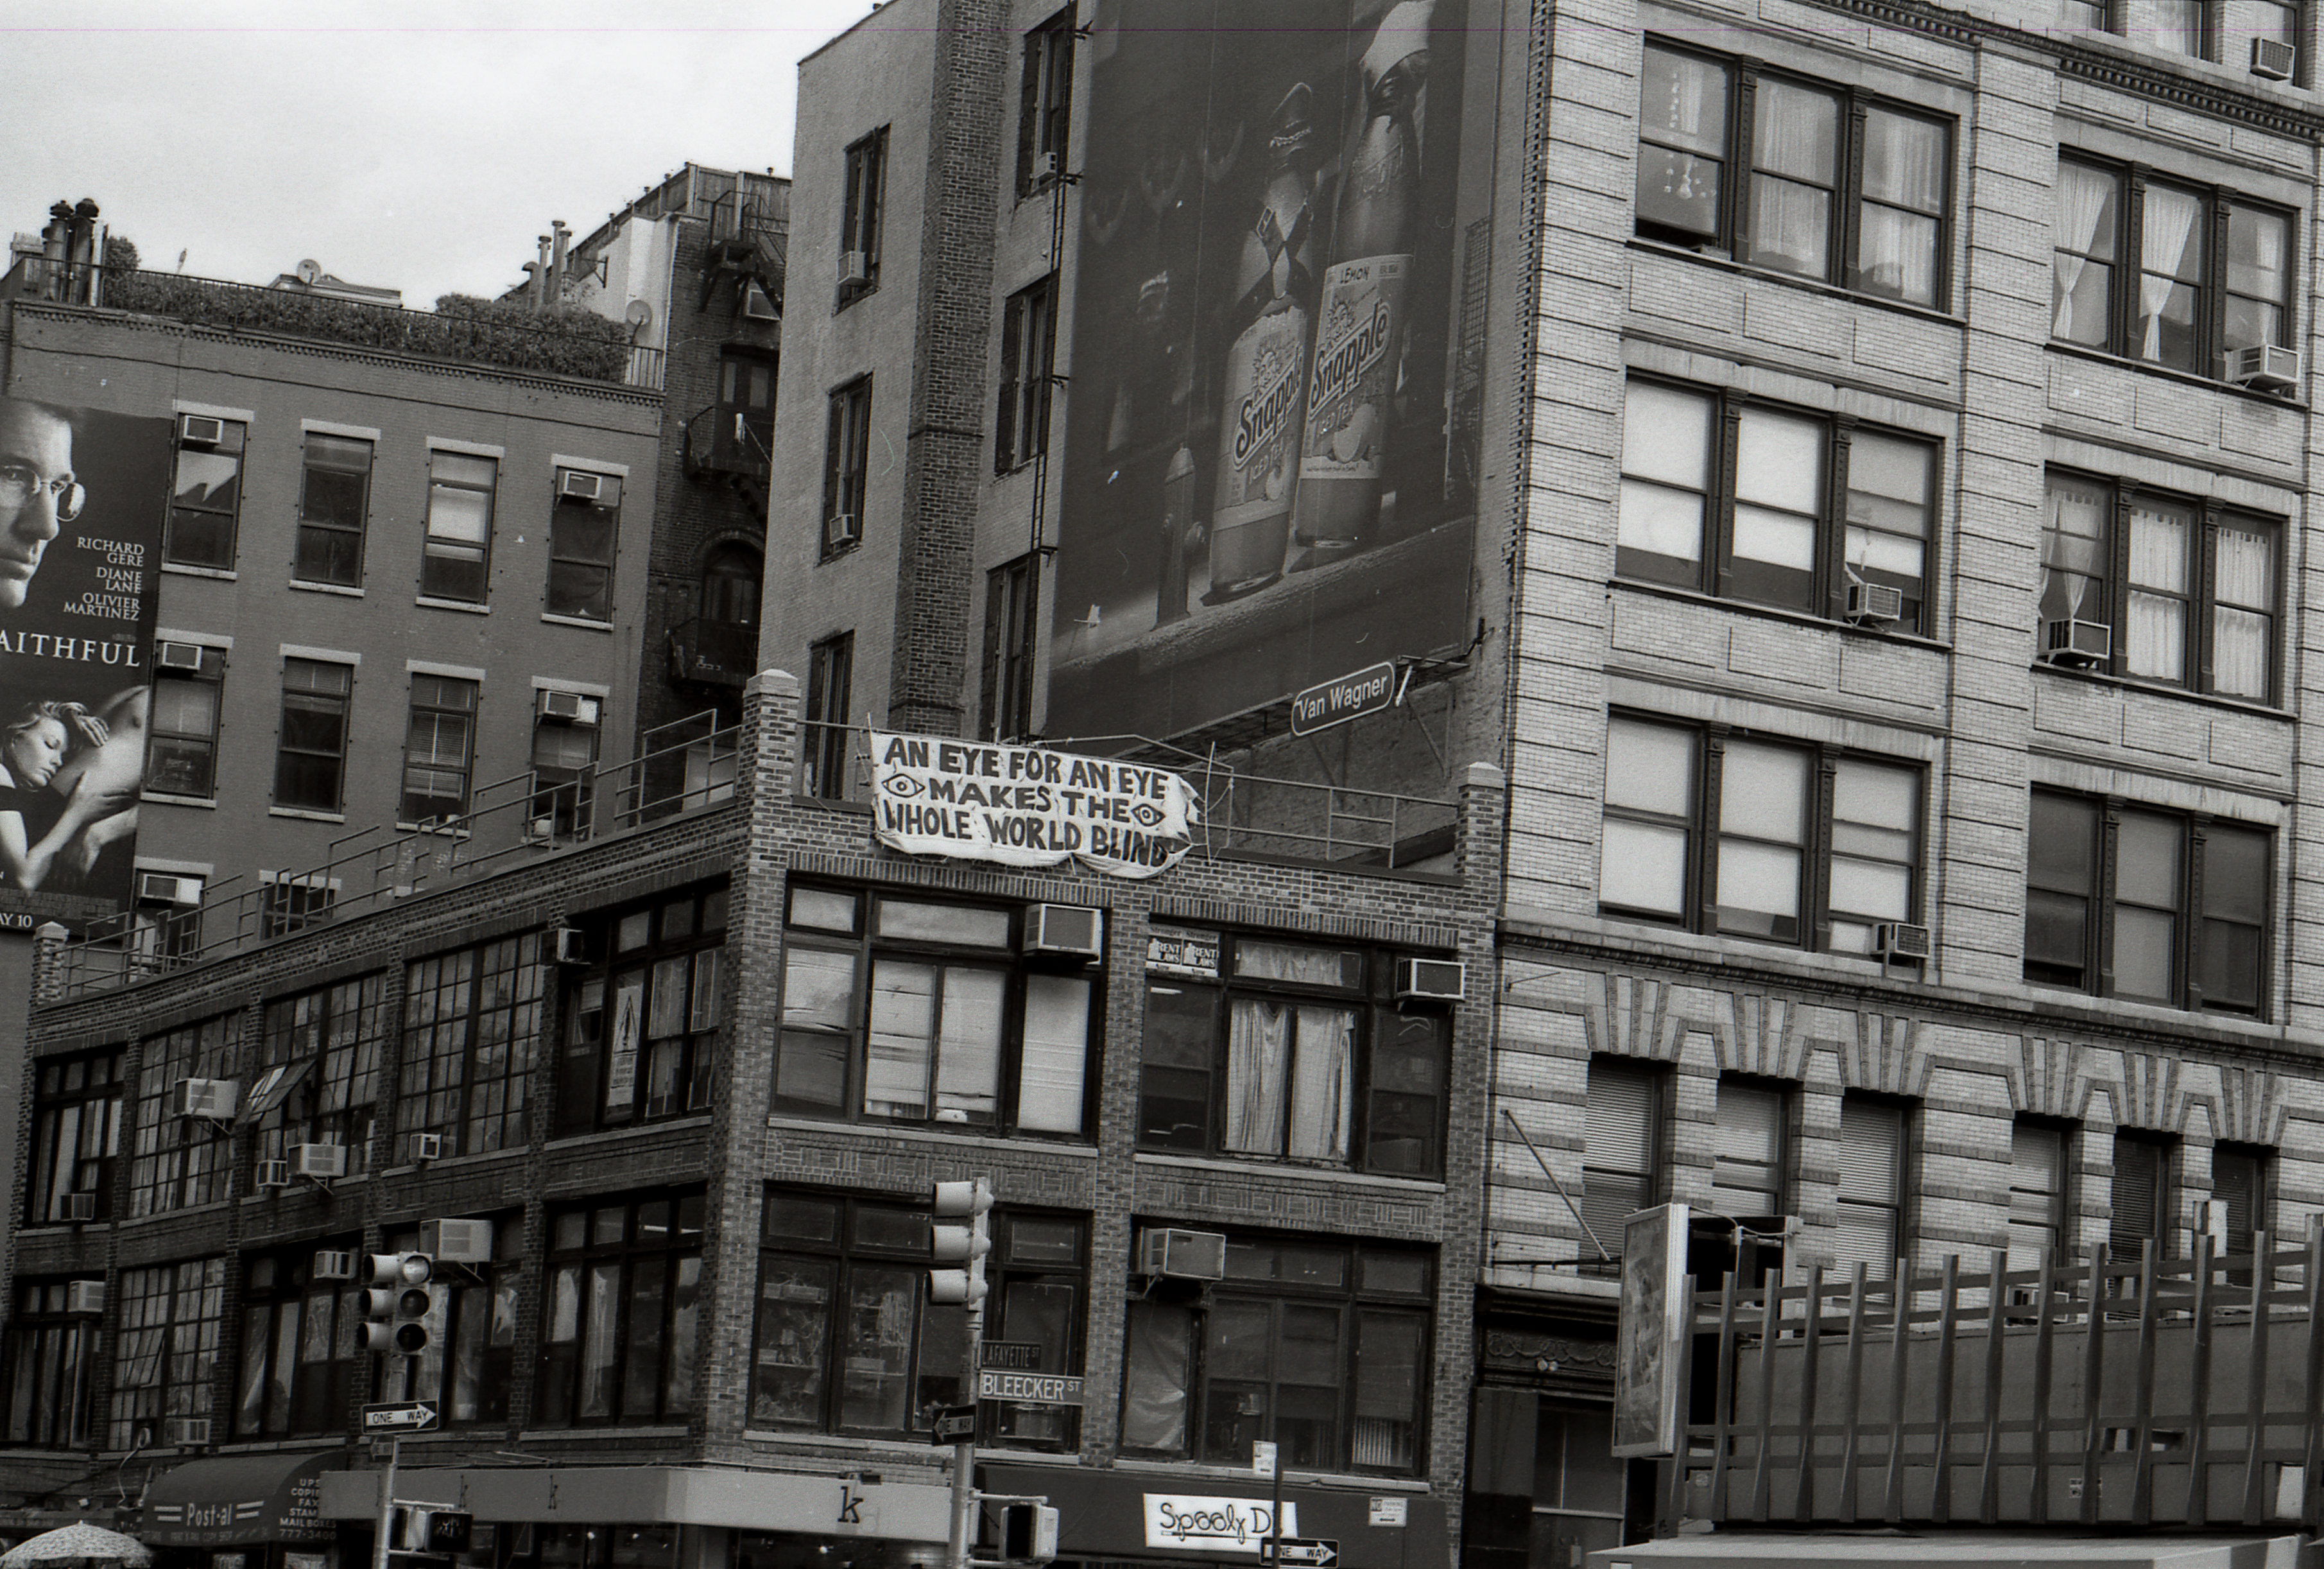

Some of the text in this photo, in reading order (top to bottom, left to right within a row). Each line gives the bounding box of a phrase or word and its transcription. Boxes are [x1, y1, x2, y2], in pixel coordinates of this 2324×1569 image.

[1339, 266, 1370, 284] LEMON
[1310, 299, 1388, 409] Snapple
[77, 537, 145, 556] RICHARD
[107, 553, 144, 567] GERE
[96, 567, 142, 583] DIANE
[105, 579, 141, 594] LANE
[82, 593, 141, 610] OLIVIER
[64, 602, 139, 621] MARTINEZ
[1295, 675, 1388, 722] Van Wagner
[884, 738, 1169, 800] AN EYE FOR AN EYE
[929, 777, 1132, 824] MAKES THE
[883, 799, 1169, 867] WHOLE WORLD BLIND
[17, 914, 33, 928] 10
[1158, 942, 1181, 954] RENT
[1194, 947, 1218, 959] RENT
[981, 1345, 1030, 1367] LAFAYETTE
[983, 1374, 1081, 1401] BLEECKER ST
[373, 1410, 429, 1424] ONE WAY
[300, 1478, 322, 1487] UPS
[298, 1498, 319, 1507] FAX
[838, 1486, 864, 1524] k
[289, 1507, 318, 1517] STAM
[280, 1517, 337, 1529] MAIL BOXES
[1250, 1507, 1283, 1534] D
[279, 1529, 337, 1540] 777-3400
[1280, 1547, 1329, 1559] NE WAY
